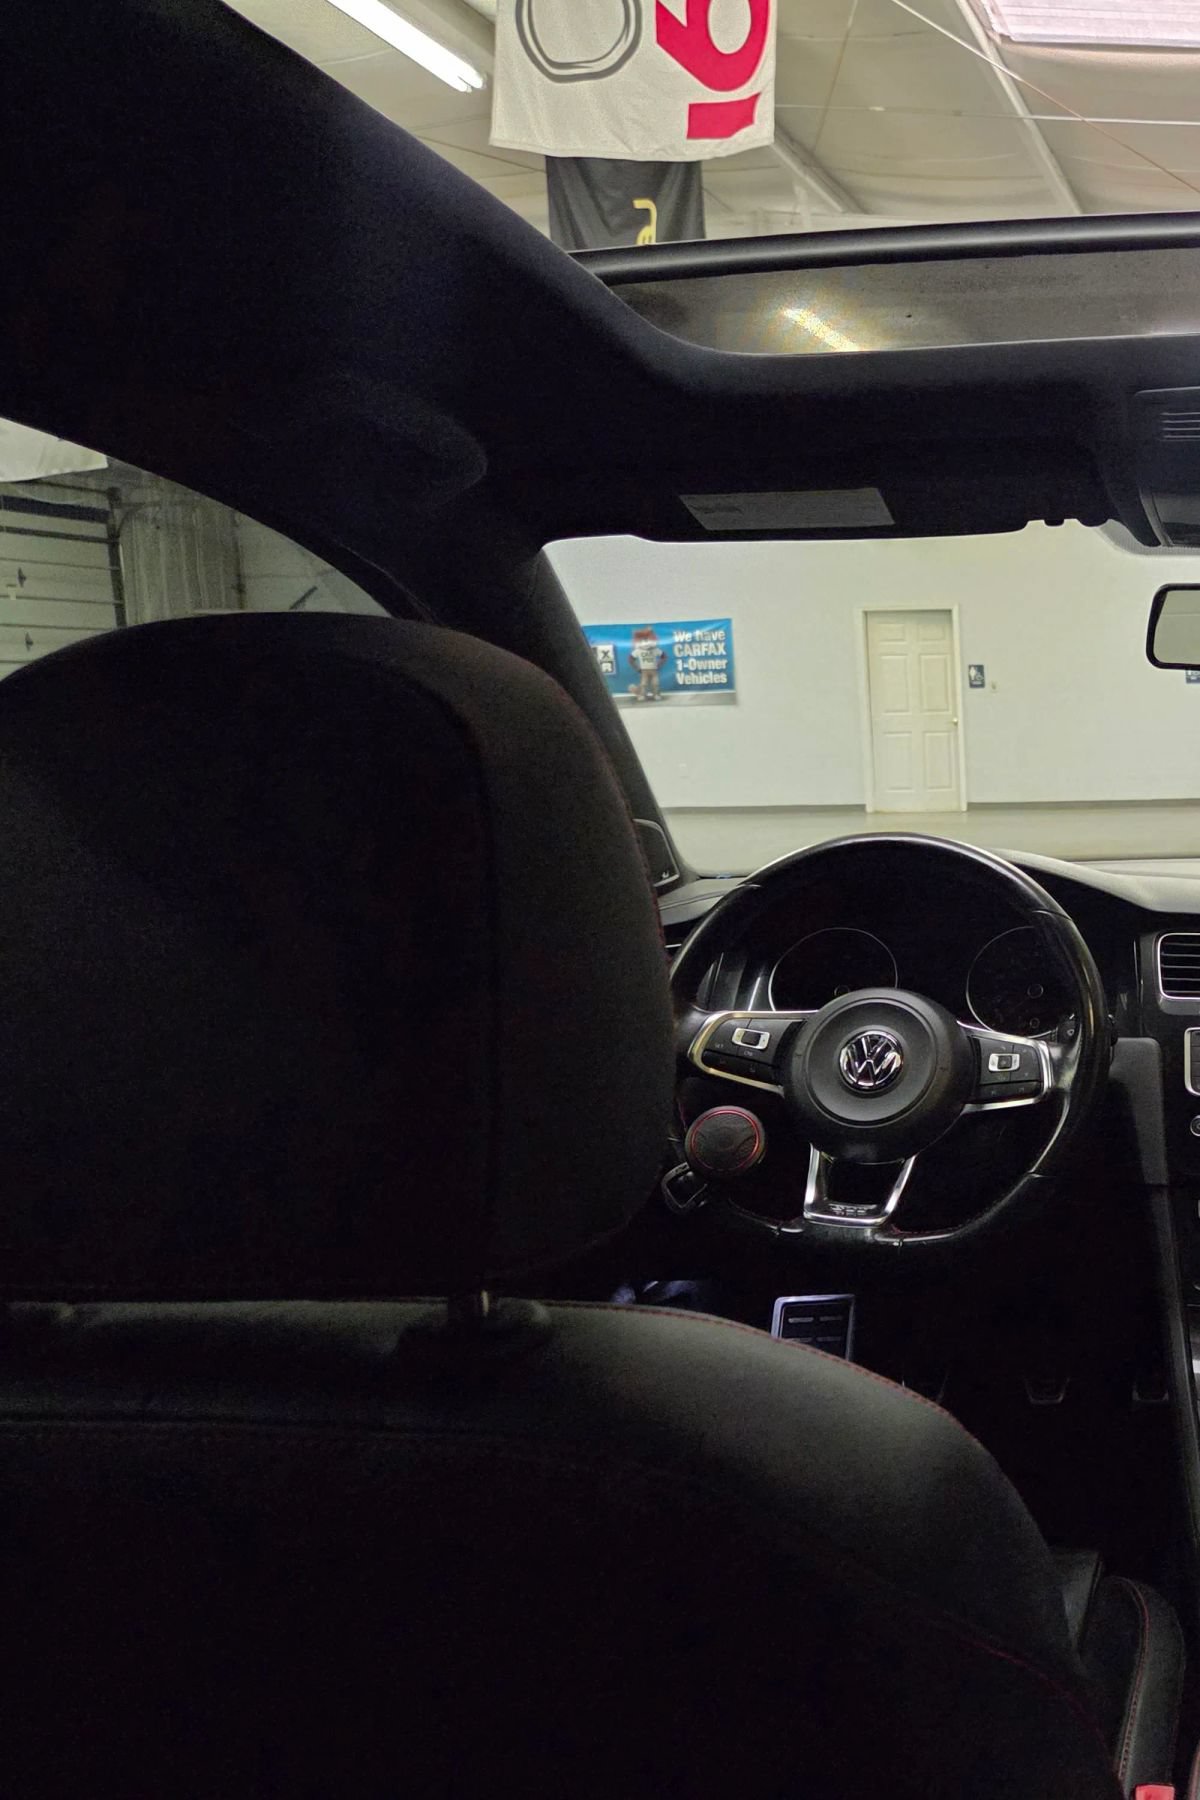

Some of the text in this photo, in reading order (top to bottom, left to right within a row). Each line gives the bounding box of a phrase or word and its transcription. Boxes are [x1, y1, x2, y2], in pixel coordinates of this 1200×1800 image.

[673, 629, 725, 642] We have
[673, 642, 726, 657] CARFAX
[676, 658, 728, 671] 1-Owner
[675, 671, 728, 685] Vehicles
